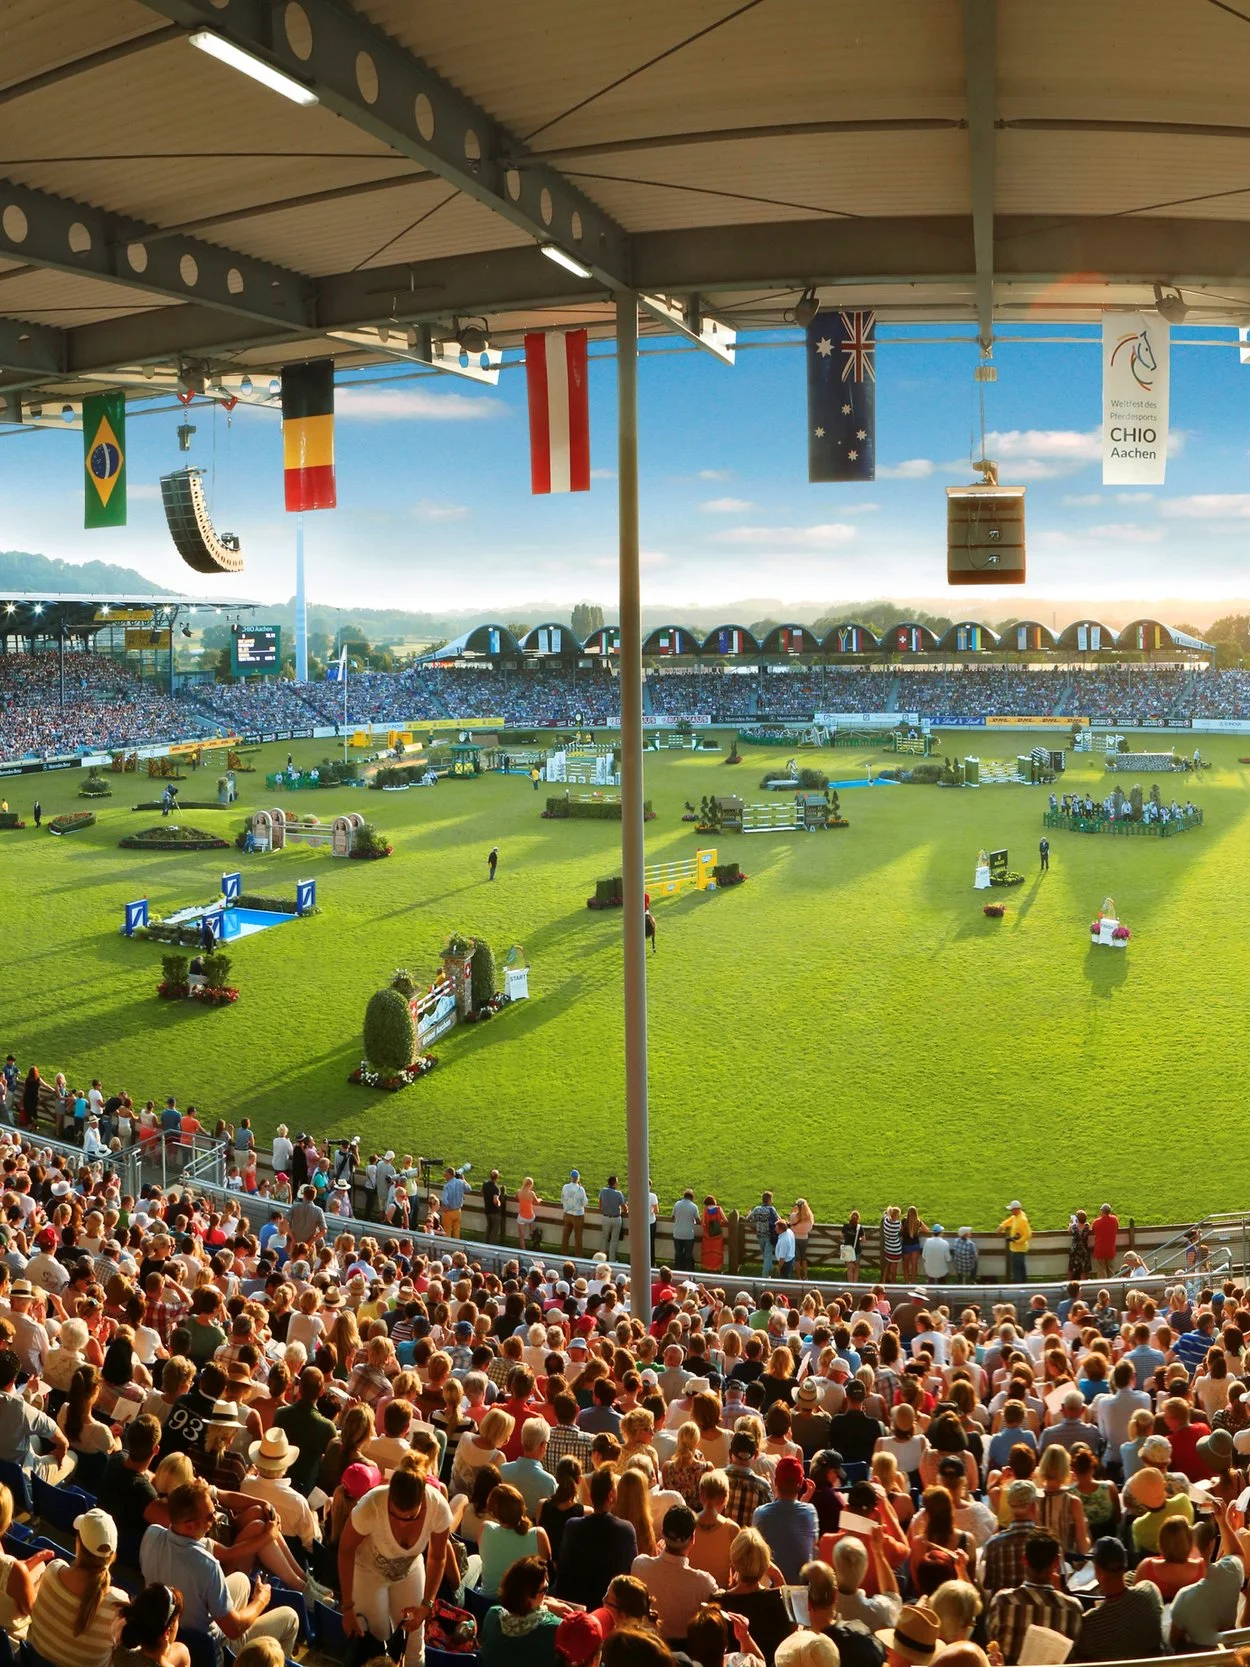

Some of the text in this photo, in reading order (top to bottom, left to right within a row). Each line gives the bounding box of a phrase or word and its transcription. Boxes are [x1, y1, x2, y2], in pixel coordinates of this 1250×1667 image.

[1110, 399, 1157, 409] Weltfest des
[1110, 412, 1157, 421] Pferdesports
[1110, 427, 1157, 443] CHIO
[1110, 447, 1156, 460] Aachen
[510, 974, 526, 982] START
[169, 1409, 204, 1441] 93
